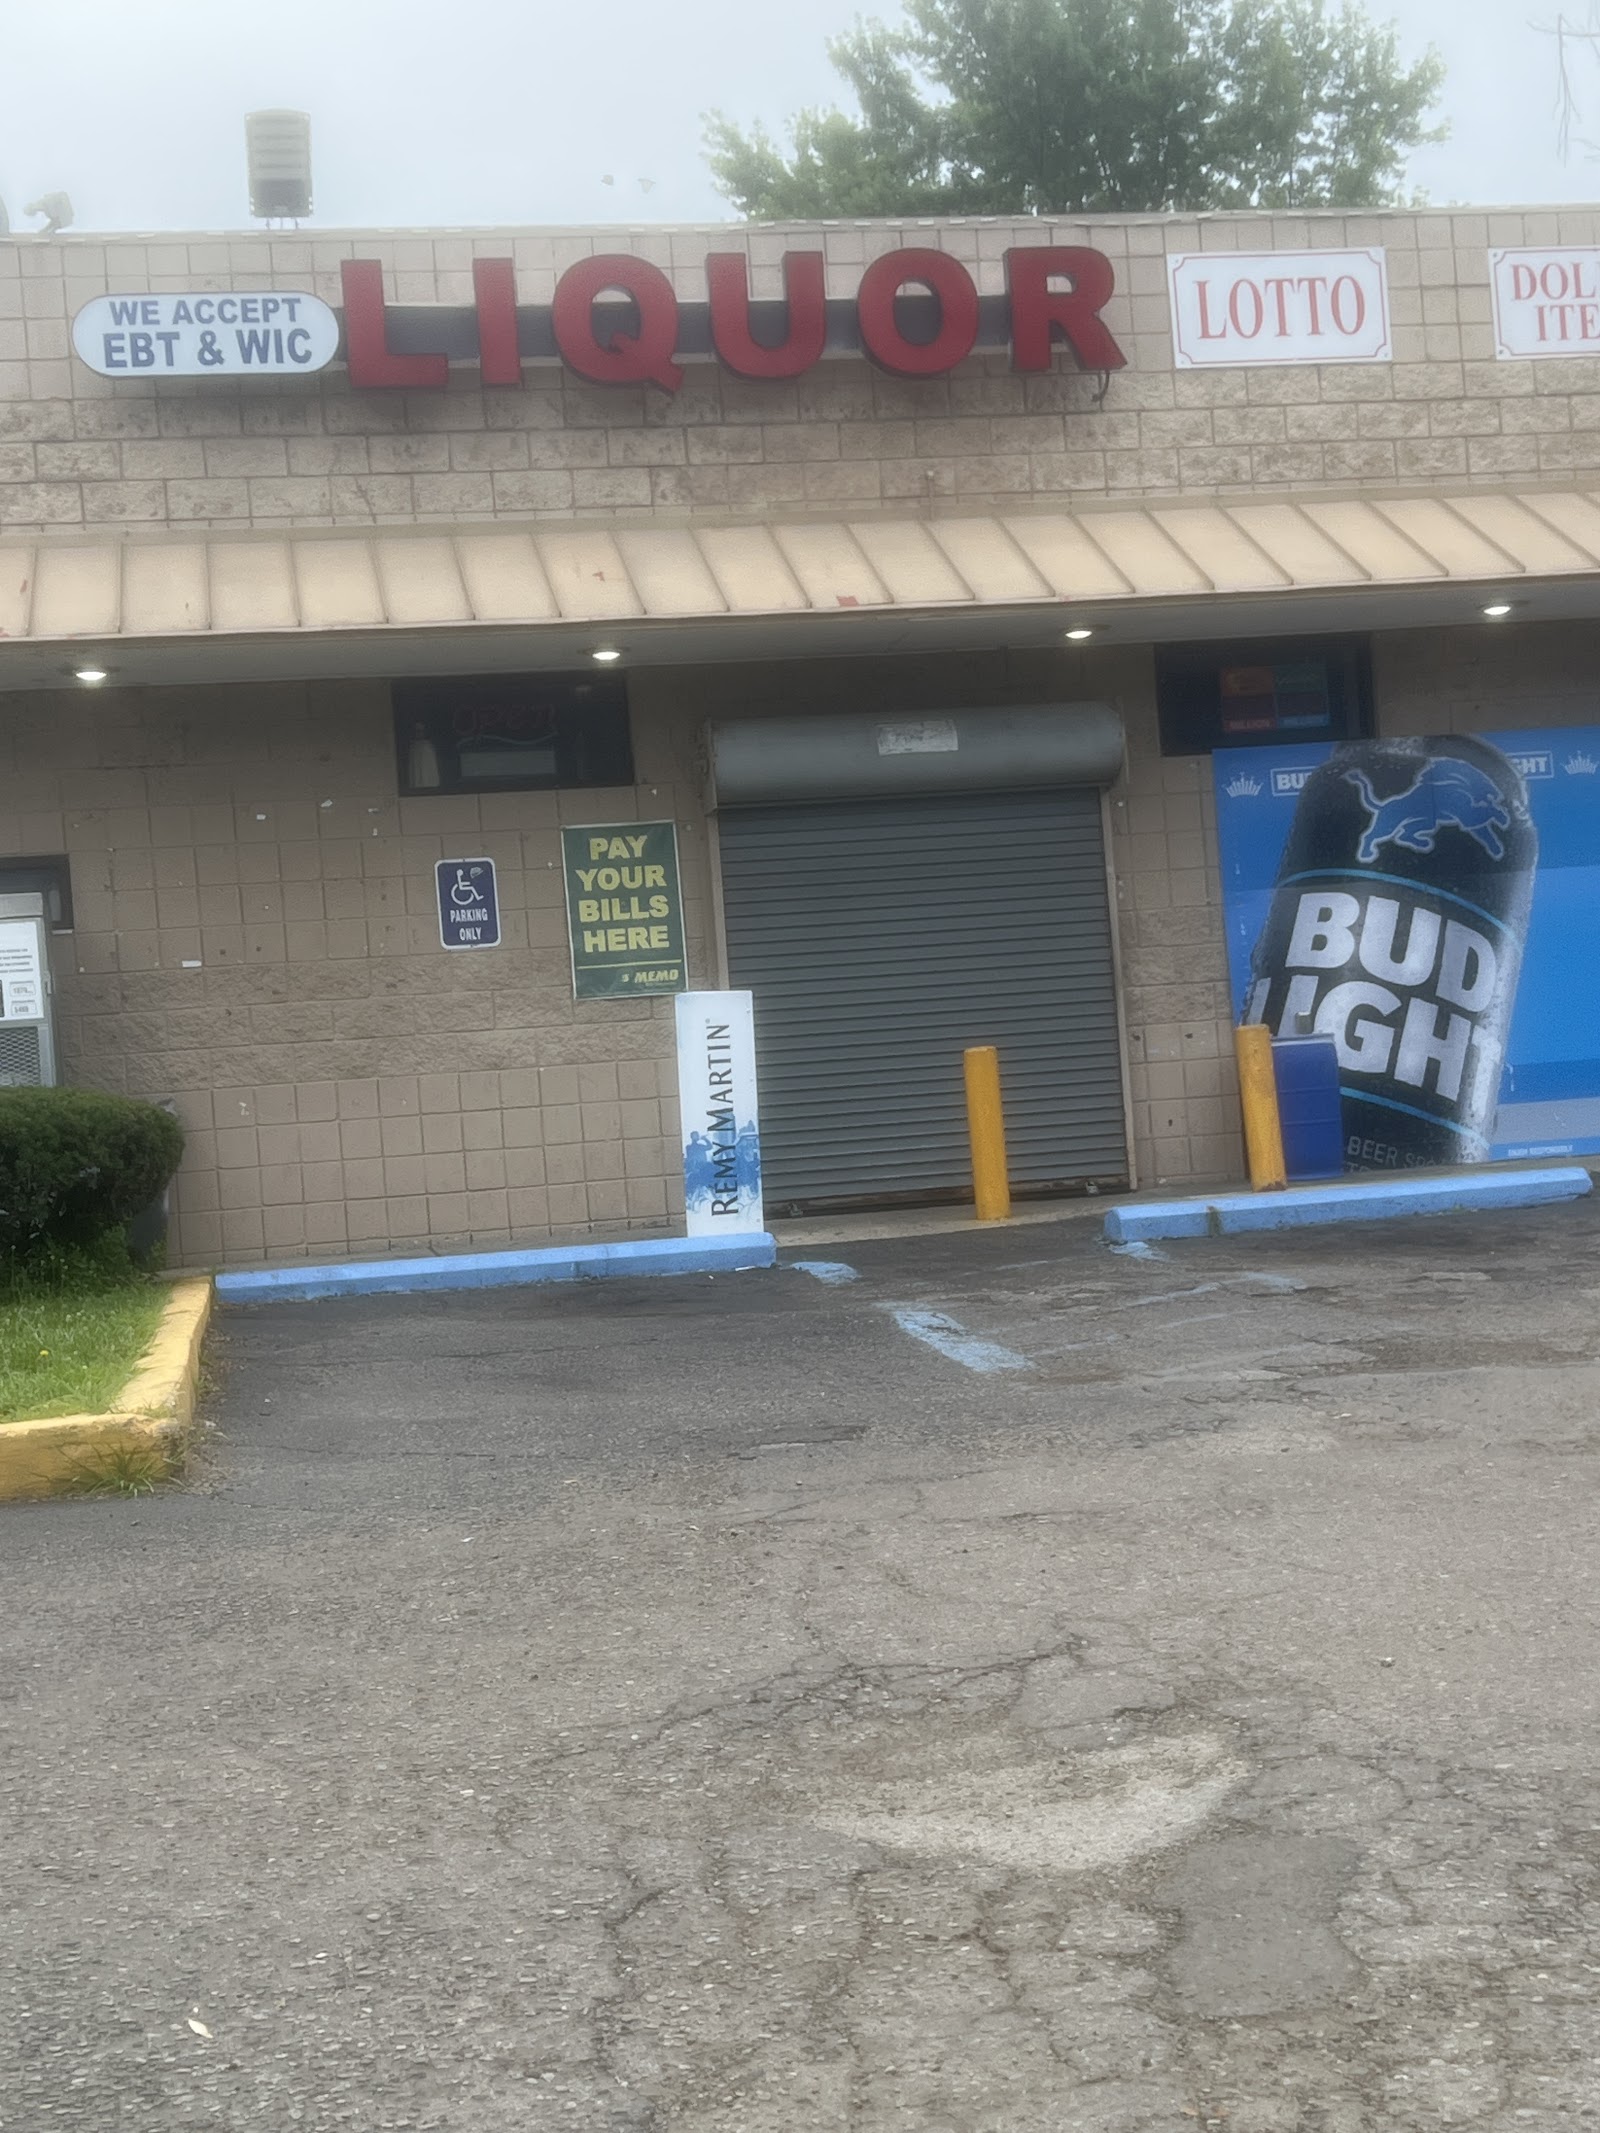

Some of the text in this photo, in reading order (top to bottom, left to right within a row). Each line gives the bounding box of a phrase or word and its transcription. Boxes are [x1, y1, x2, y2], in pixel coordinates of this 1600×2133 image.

[1510, 262, 1600, 301] DOL
[108, 298, 301, 326] WE ACCEPT
[341, 246, 1127, 391] LIQUOR
[1193, 275, 1366, 340] LOTTO
[102, 327, 313, 369] EBT & WIC
[589, 835, 648, 861] PAY
[575, 864, 667, 892] YOUR
[450, 908, 488, 923] PARKING
[578, 895, 670, 923] BILLS
[459, 927, 482, 940] ONLY
[583, 925, 670, 953] HERE
[1285, 892, 1497, 1013] BUD
[634, 968, 679, 984] MEMO
[706, 1024, 734, 1131] MARTIN
[1347, 1136, 1398, 1168] BEER
